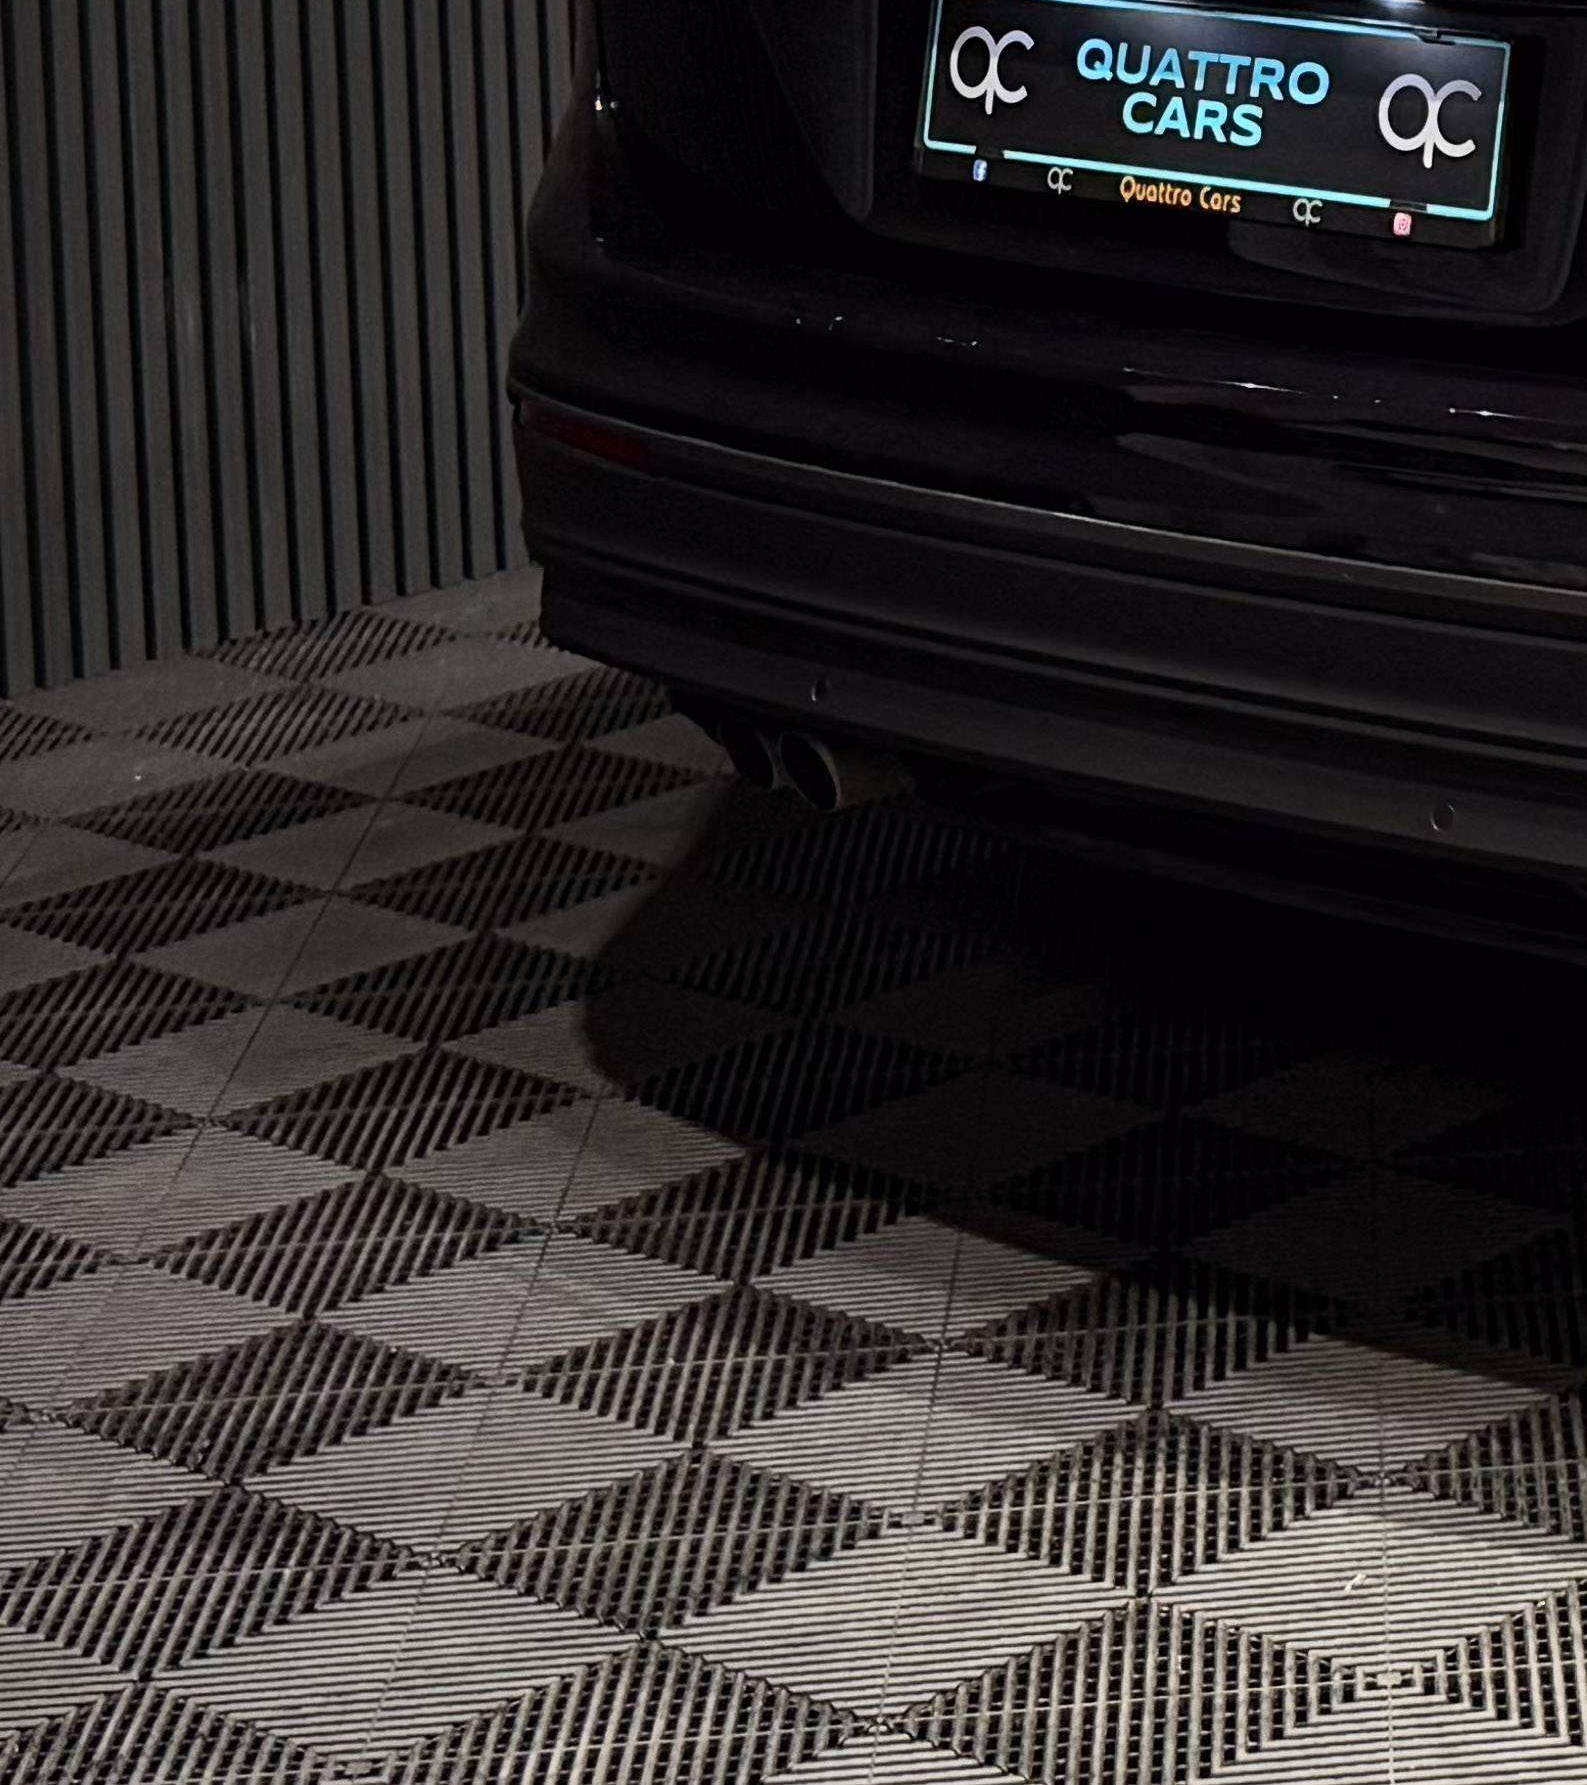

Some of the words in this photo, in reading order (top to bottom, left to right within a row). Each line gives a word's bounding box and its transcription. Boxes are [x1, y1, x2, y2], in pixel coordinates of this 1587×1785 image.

[1076, 38, 1330, 105] QUATTRO
[1121, 91, 1264, 147] CARS
[1119, 175, 1193, 203] Quattro
[1199, 186, 1242, 213] Cars
